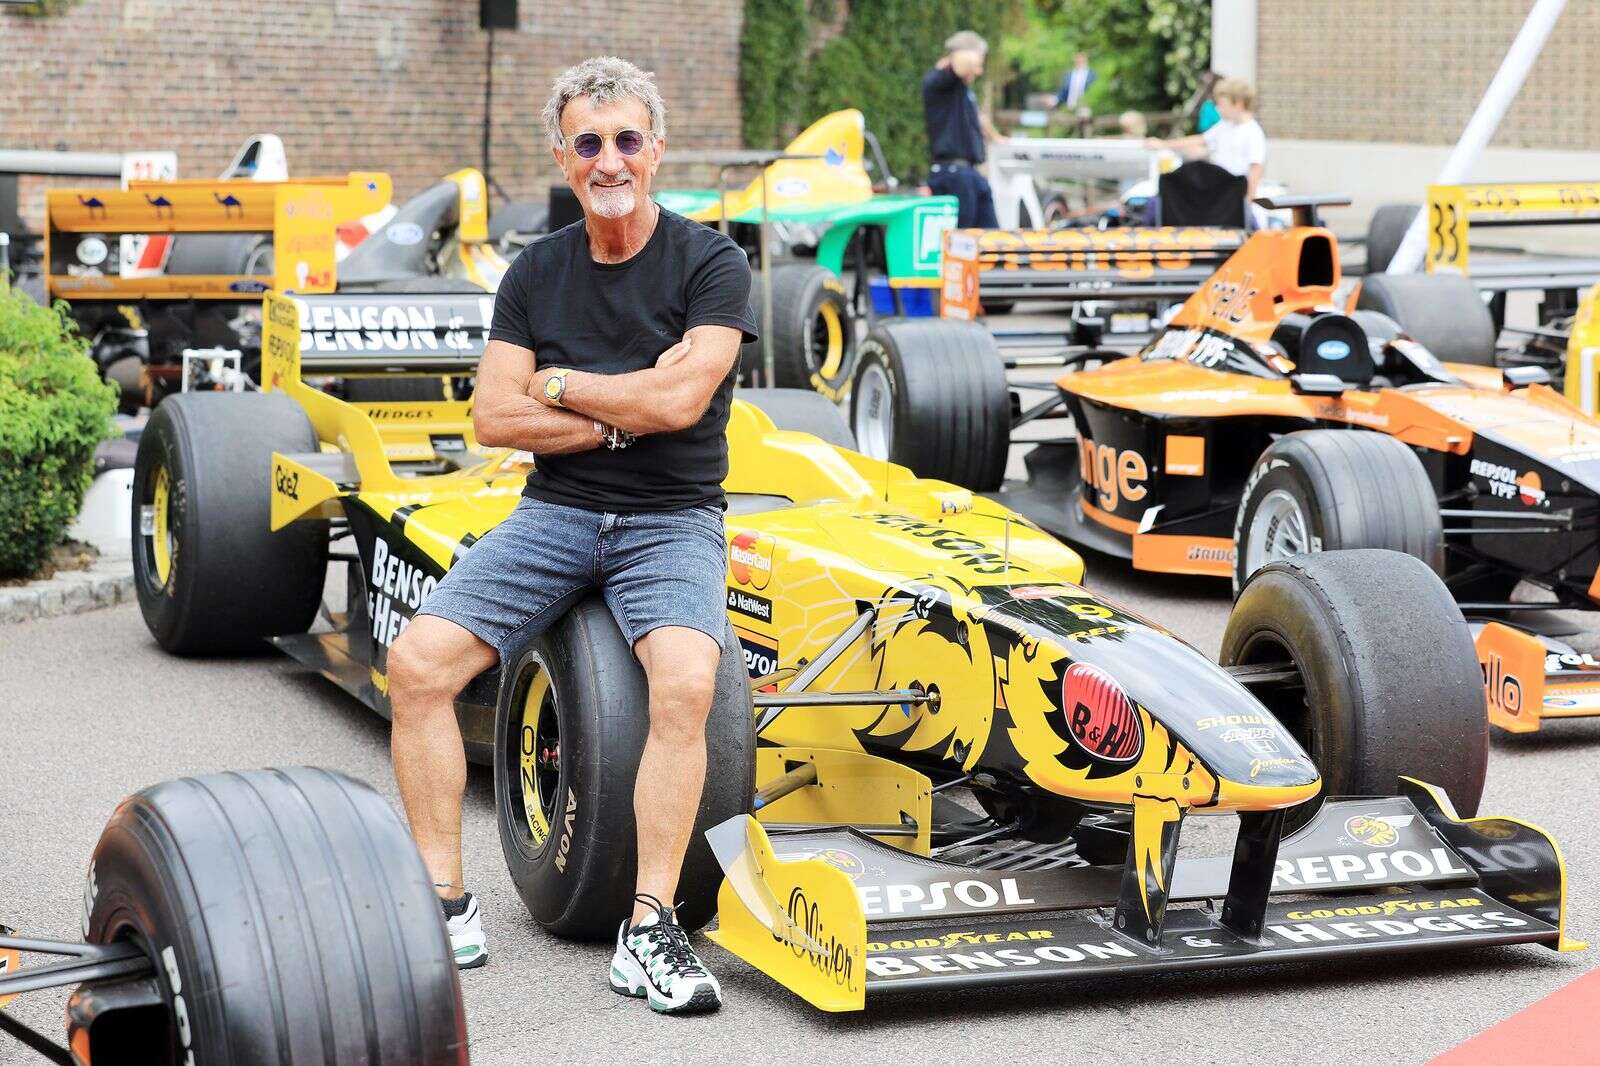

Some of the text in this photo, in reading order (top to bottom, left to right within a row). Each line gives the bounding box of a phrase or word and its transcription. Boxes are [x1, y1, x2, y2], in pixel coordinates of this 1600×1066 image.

[368, 407, 433, 419] HEDGES
[1077, 436, 1148, 512] nge
[1470, 459, 1517, 485] REPSOL
[731, 544, 771, 573] MasterCard
[737, 593, 770, 618] NatWest
[743, 649, 777, 675] PSOL
[1481, 652, 1522, 717] llo
[554, 785, 578, 874] AVON
[1271, 847, 1467, 887] REPSOL
[857, 878, 1036, 915] EPSOL
[866, 929, 1055, 952] OODYEAR
[866, 911, 1528, 977] BENSON & HEDGES
